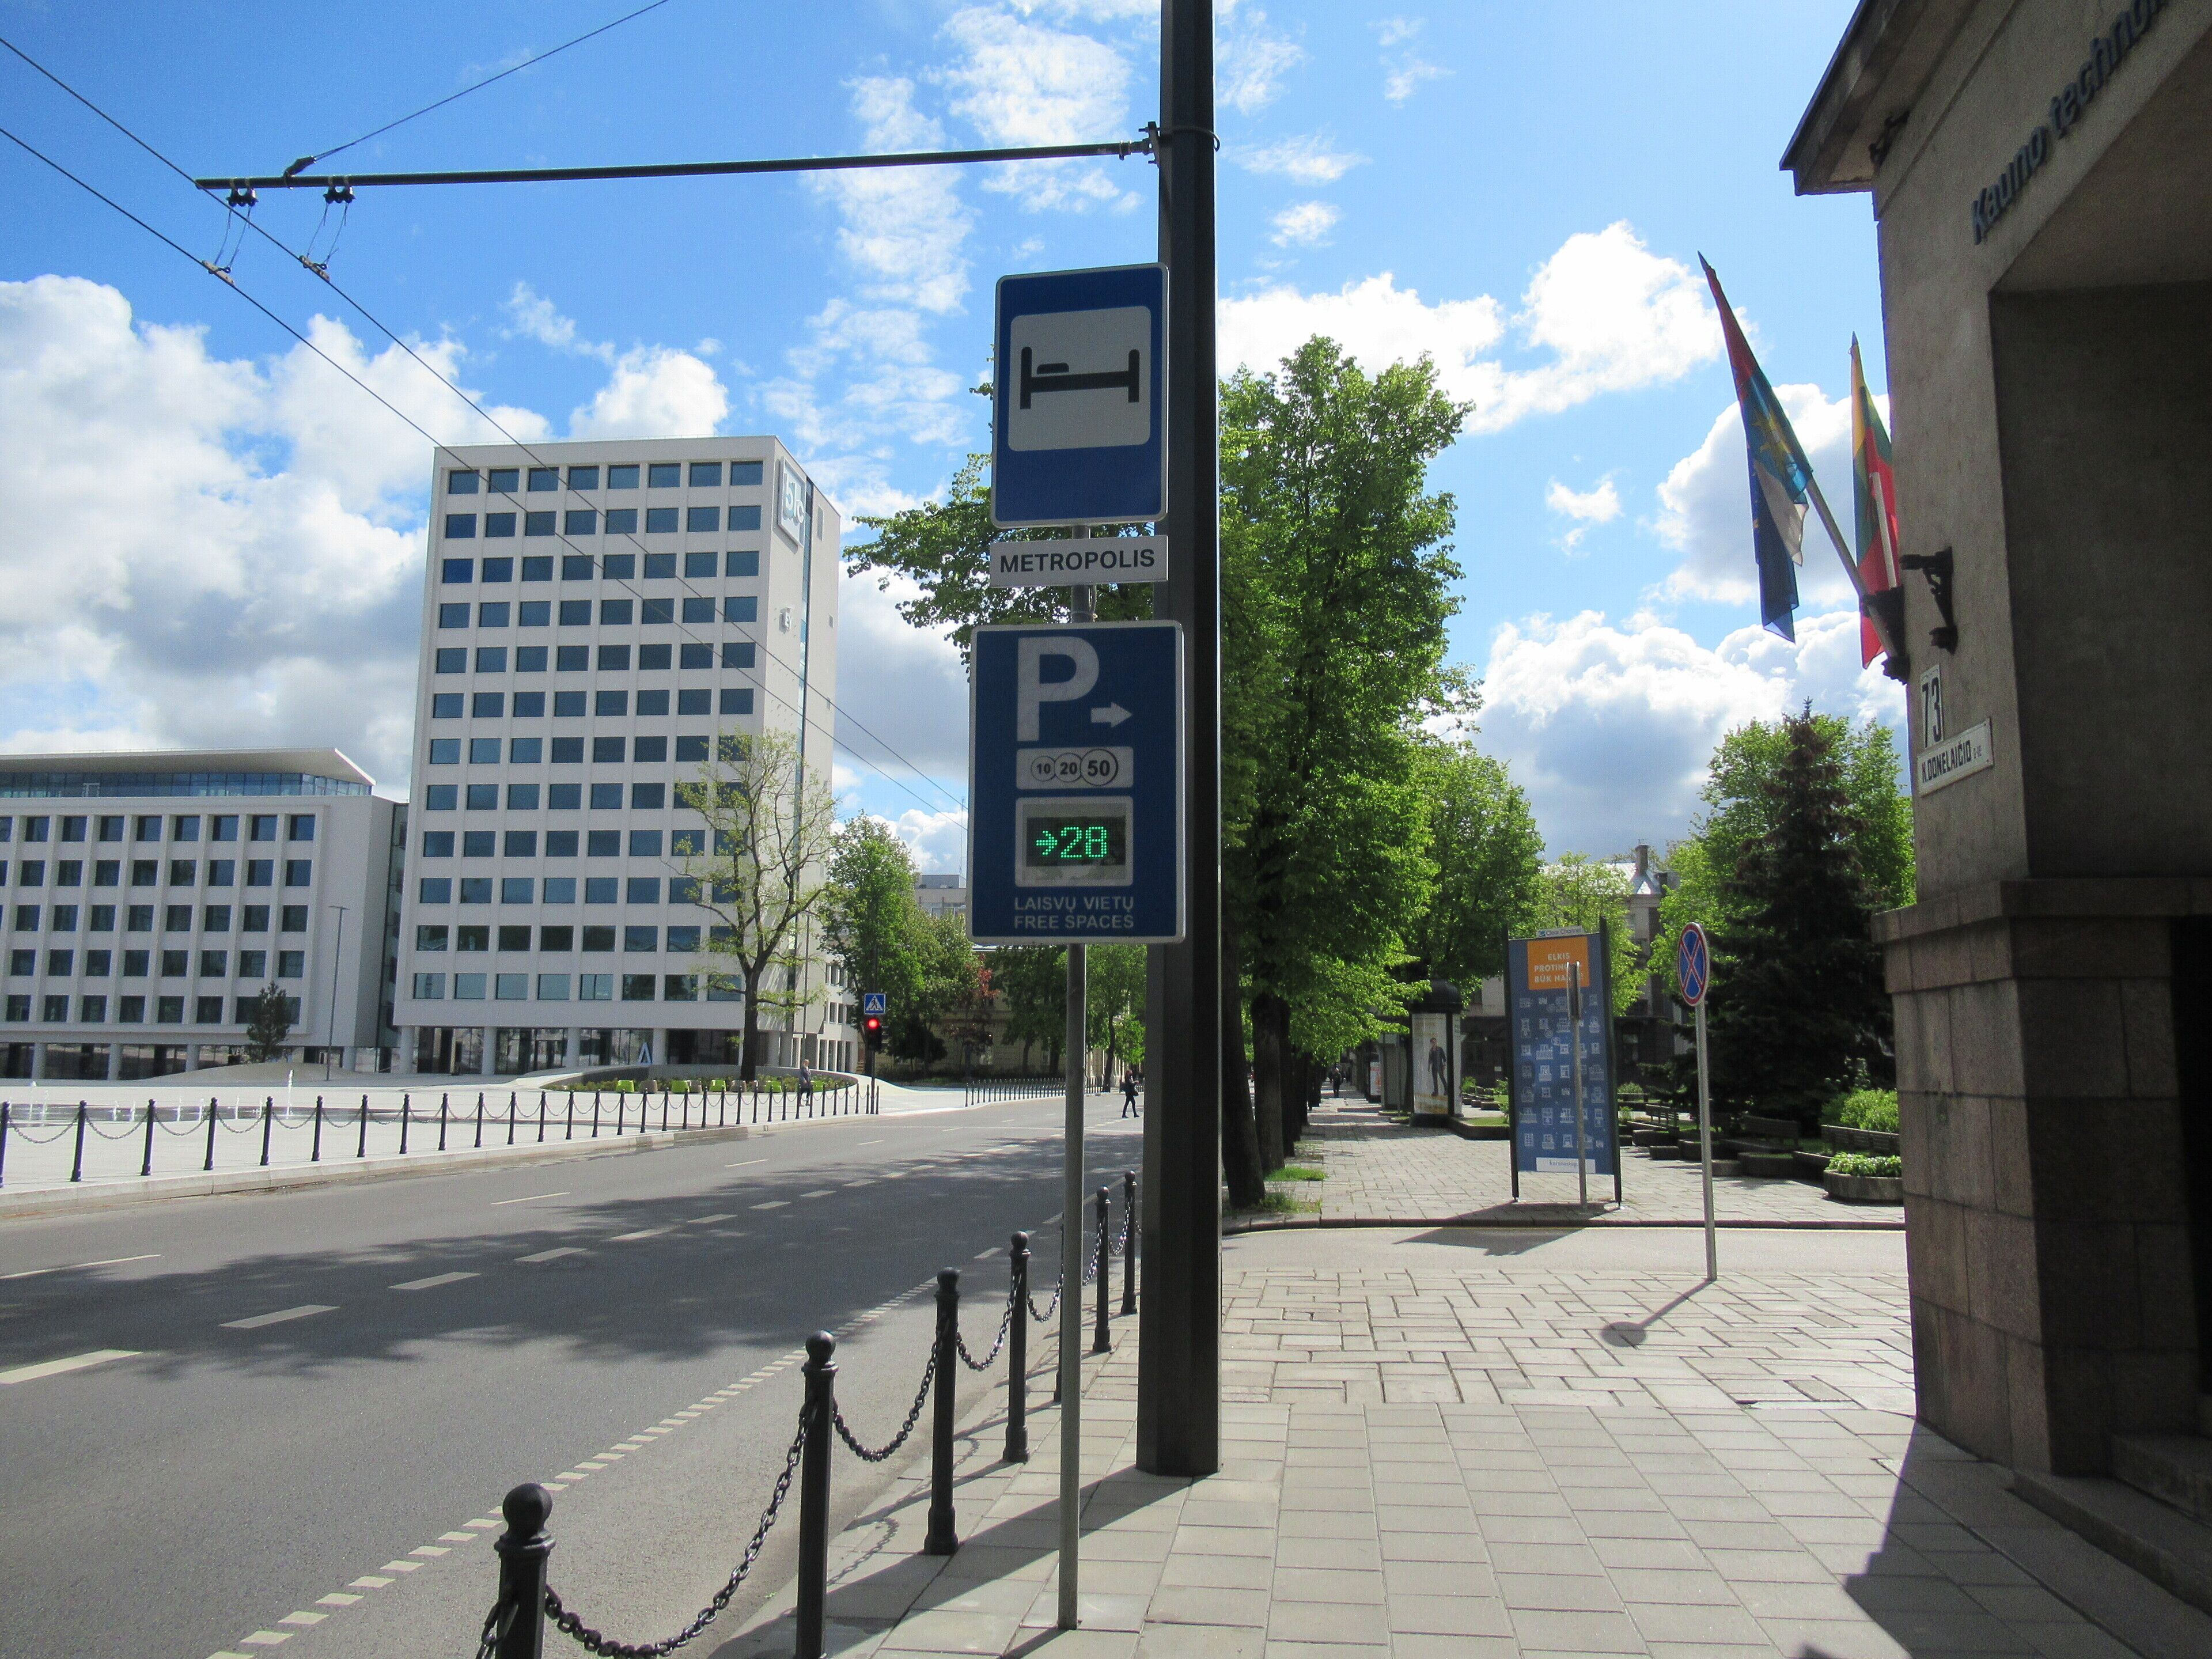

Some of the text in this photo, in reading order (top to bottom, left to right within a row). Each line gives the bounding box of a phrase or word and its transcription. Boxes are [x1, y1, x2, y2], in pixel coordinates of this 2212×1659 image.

[1971, 125, 2048, 245] Kauno
[1001, 548, 1155, 573] METROPOLIS
[1017, 636, 1099, 741] P
[1922, 677, 1941, 748] 73
[1037, 760, 1111, 777] 10 20 50
[1060, 826, 1107, 858] 28
[1014, 895, 1134, 913] LAISVŲ VIETŲ
[1014, 915, 1134, 929] FREE SPACES
[1547, 953, 1570, 961] ELKIS
